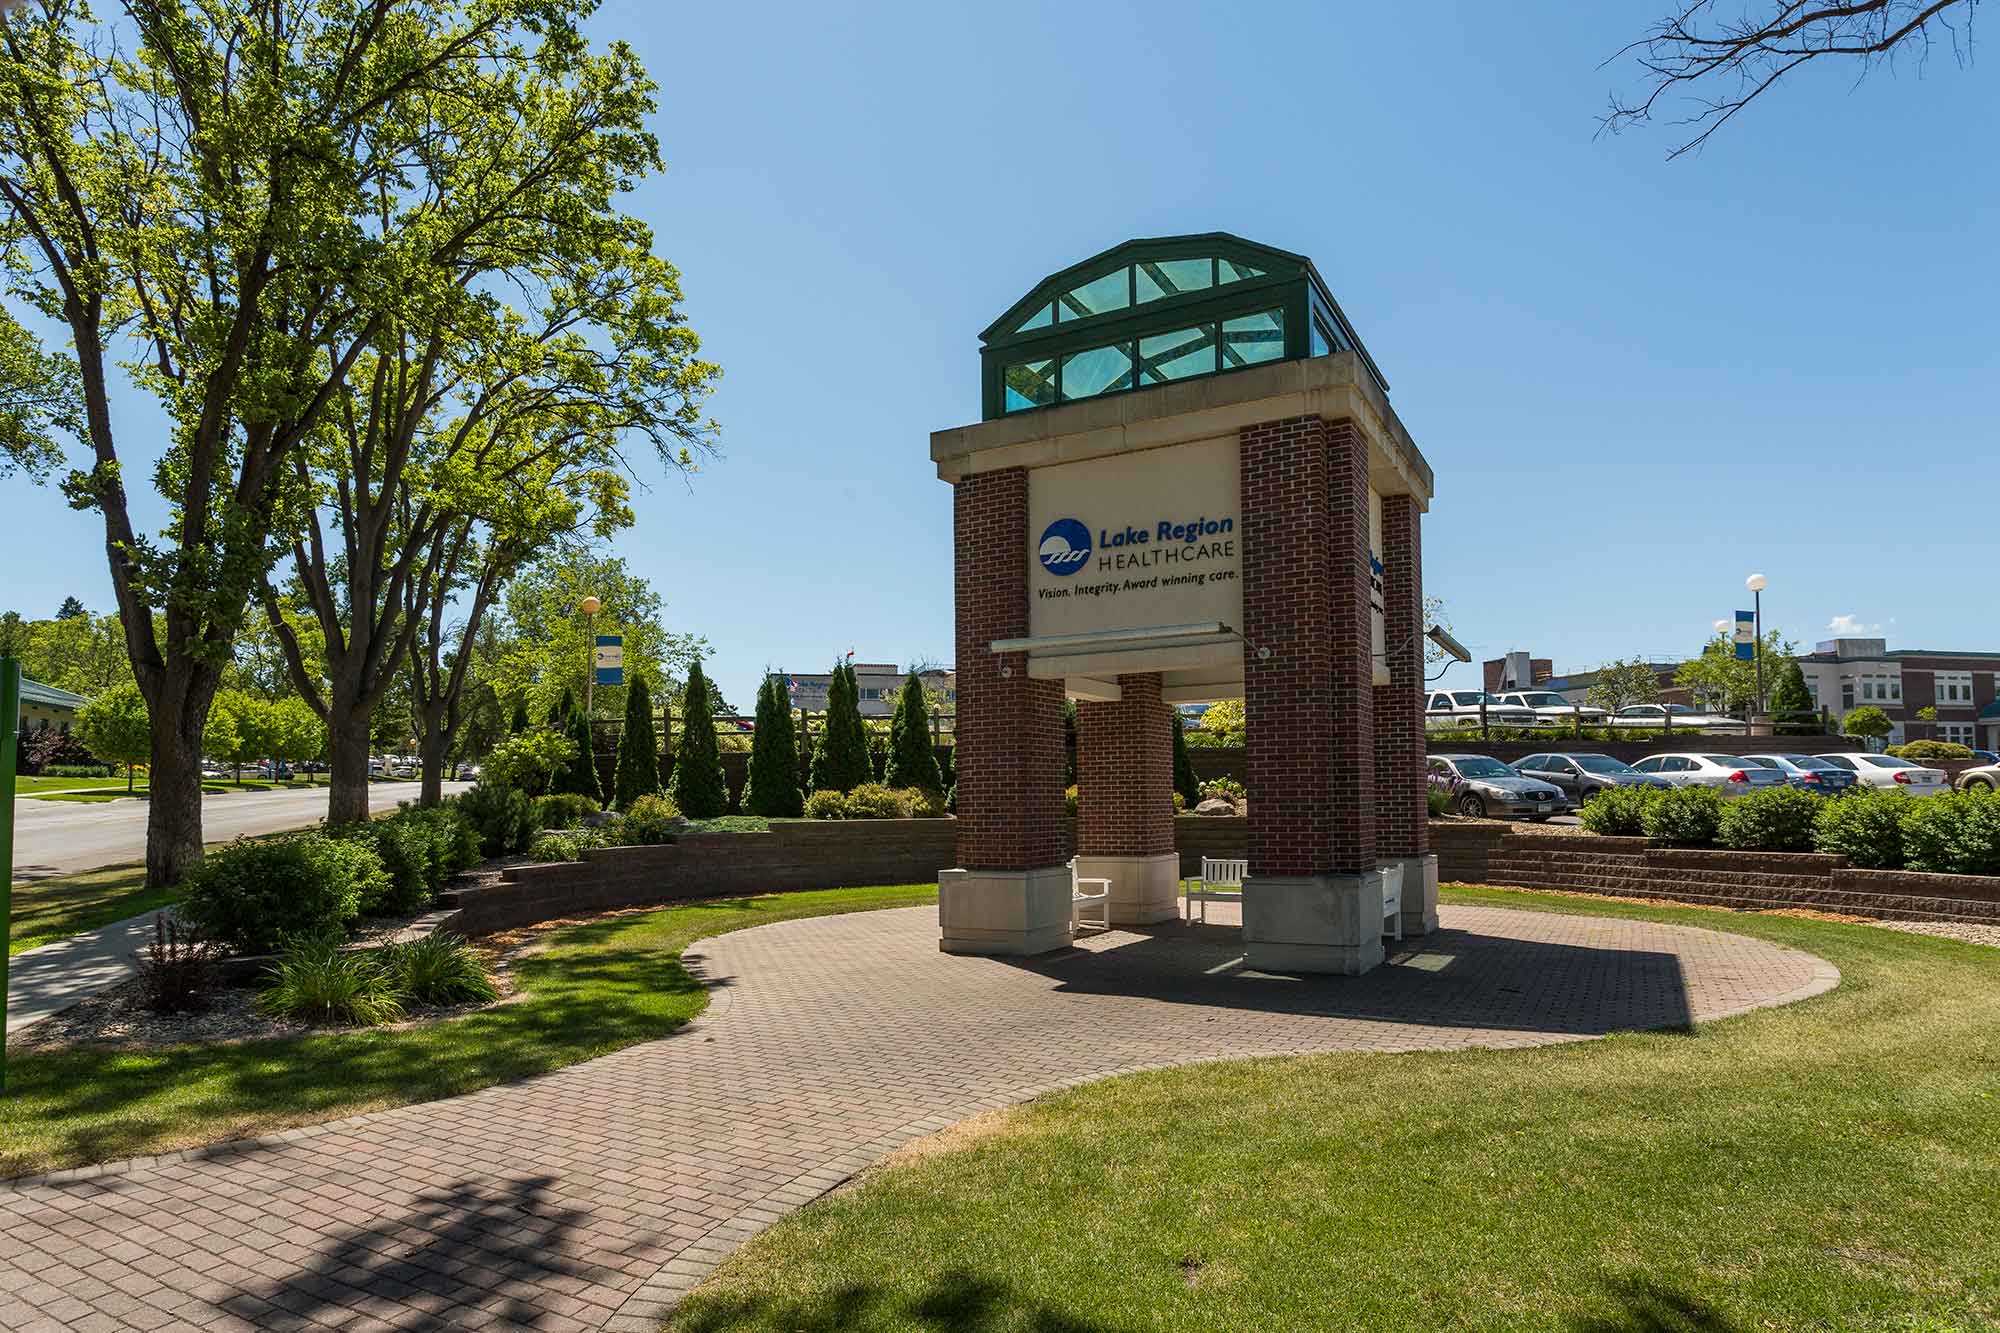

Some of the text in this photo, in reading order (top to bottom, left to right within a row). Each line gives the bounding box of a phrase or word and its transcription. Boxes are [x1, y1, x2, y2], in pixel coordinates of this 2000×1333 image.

[1100, 516, 1233, 549] Lake Region
[1099, 541, 1234, 571] HEALTHCARE
[1039, 570, 1239, 599] Vision. Integrity. Award winning care.
